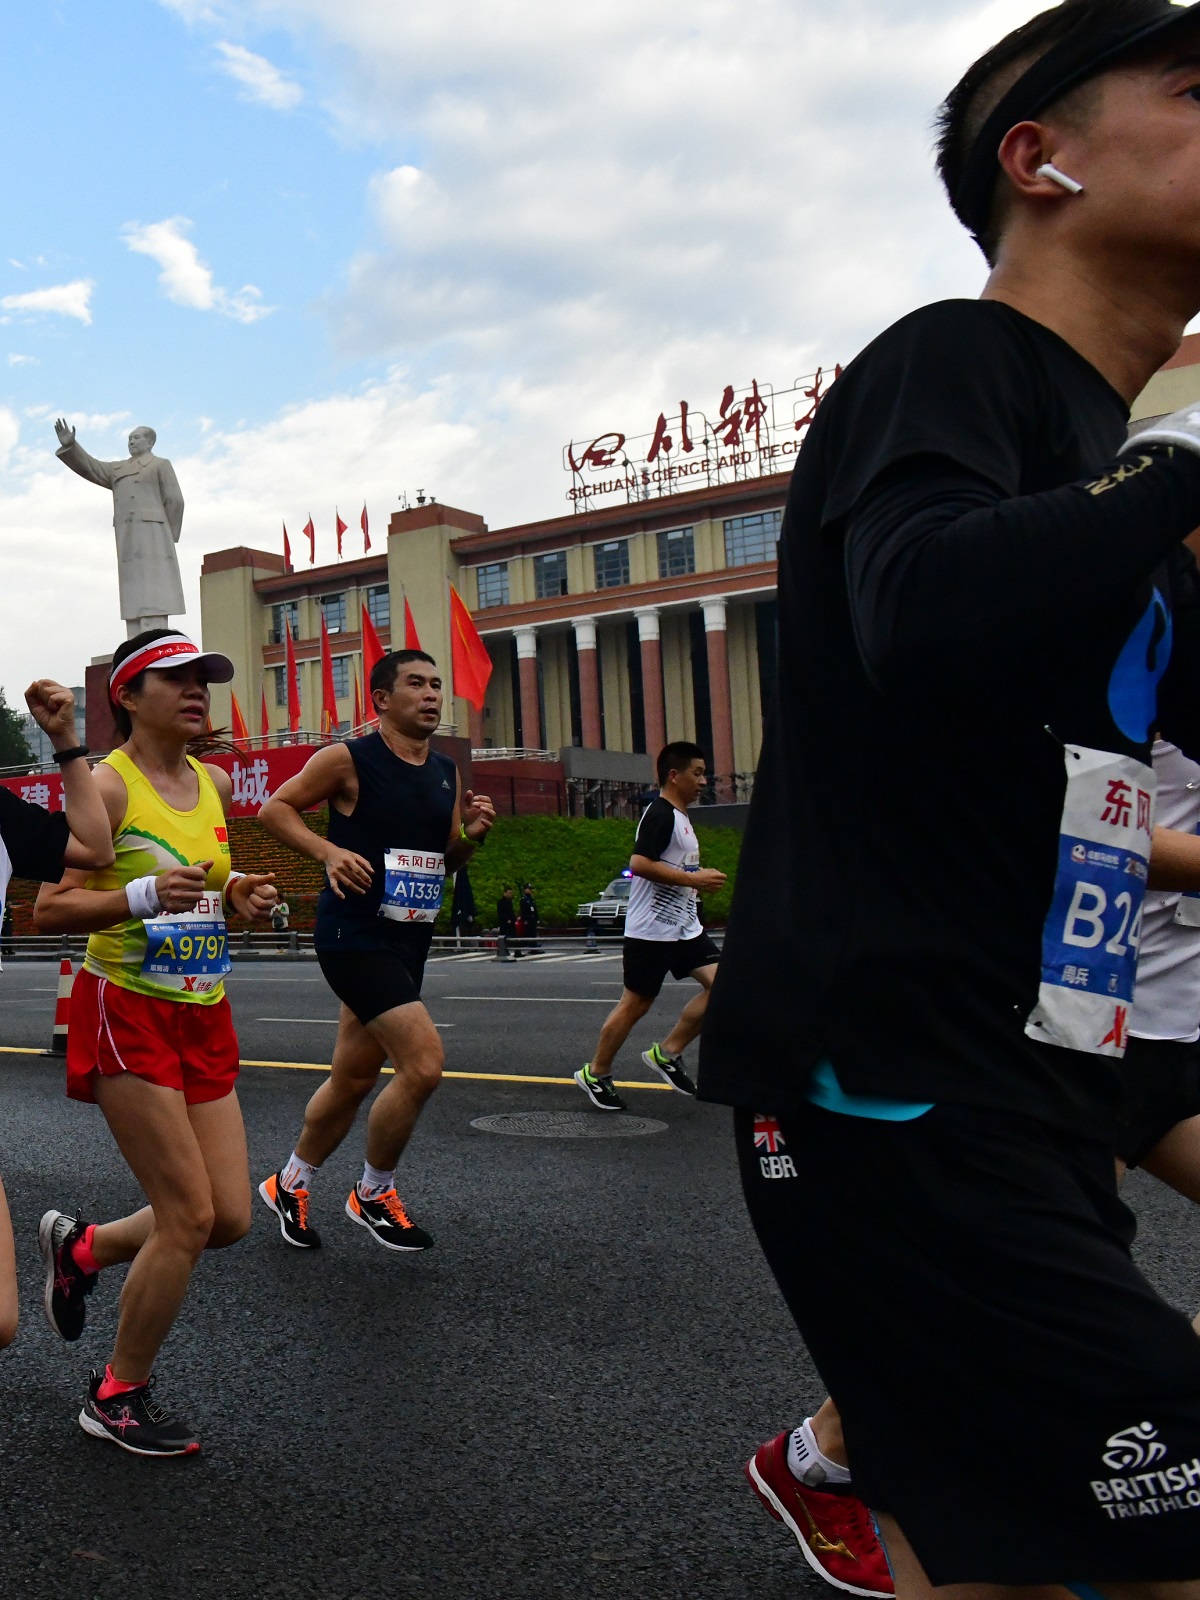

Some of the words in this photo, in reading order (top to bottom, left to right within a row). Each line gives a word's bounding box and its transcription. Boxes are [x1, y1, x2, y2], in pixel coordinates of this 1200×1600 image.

[569, 475, 636, 500] SICHUAN
[641, 459, 710, 486] SCIENCE
[717, 451, 752, 469] AND
[231, 759, 270, 808] 城
[1100, 779, 1150, 836] 东风
[394, 881, 440, 900] A1339
[155, 936, 225, 960] A9797
[1062, 964, 1090, 986] 周兵
[760, 1155, 798, 1178] GBR
[1090, 1456, 1200, 1501] BRITISH
[1101, 1489, 1200, 1519] TRIATHLO
